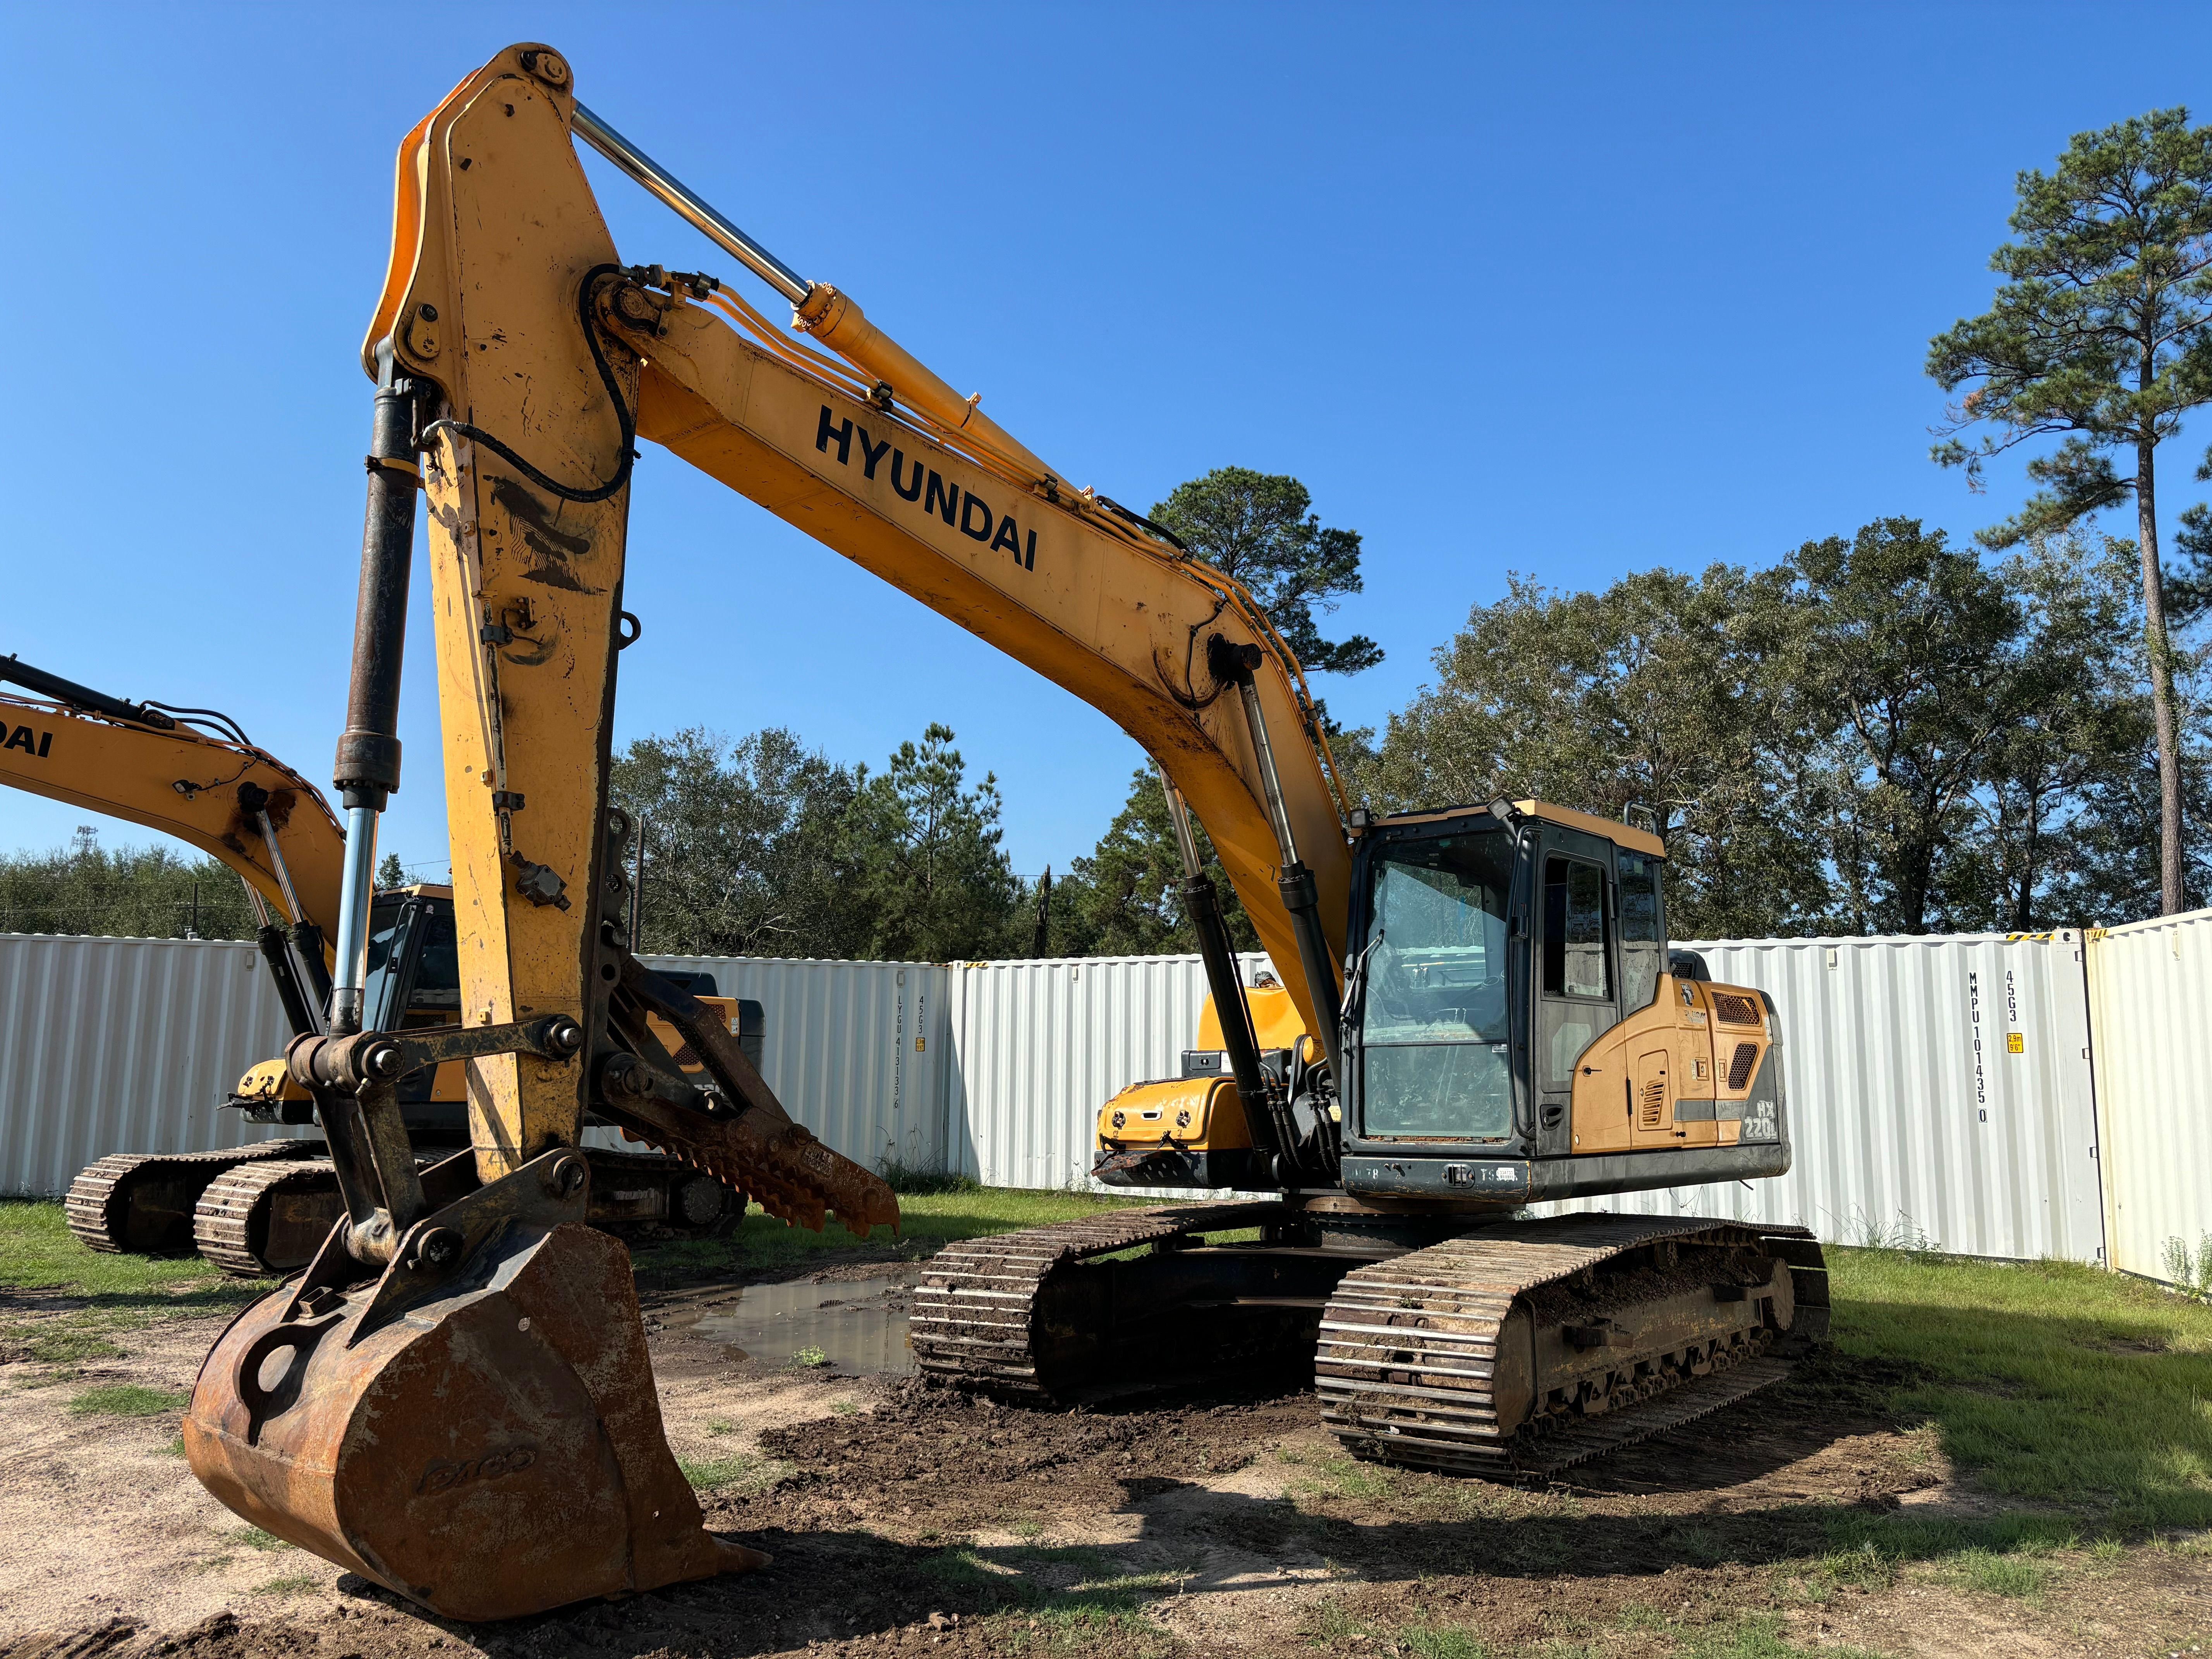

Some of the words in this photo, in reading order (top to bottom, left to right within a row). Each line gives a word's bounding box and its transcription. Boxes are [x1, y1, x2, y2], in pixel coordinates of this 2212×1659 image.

[816, 404, 1037, 572] HYUNDAI
[0, 721, 53, 758] AI
[2006, 970, 2016, 1022] 45G3
[1969, 972, 1979, 1023] MMPU
[1974, 1026, 1985, 1103] 101435
[1757, 1100, 1775, 1119] HX
